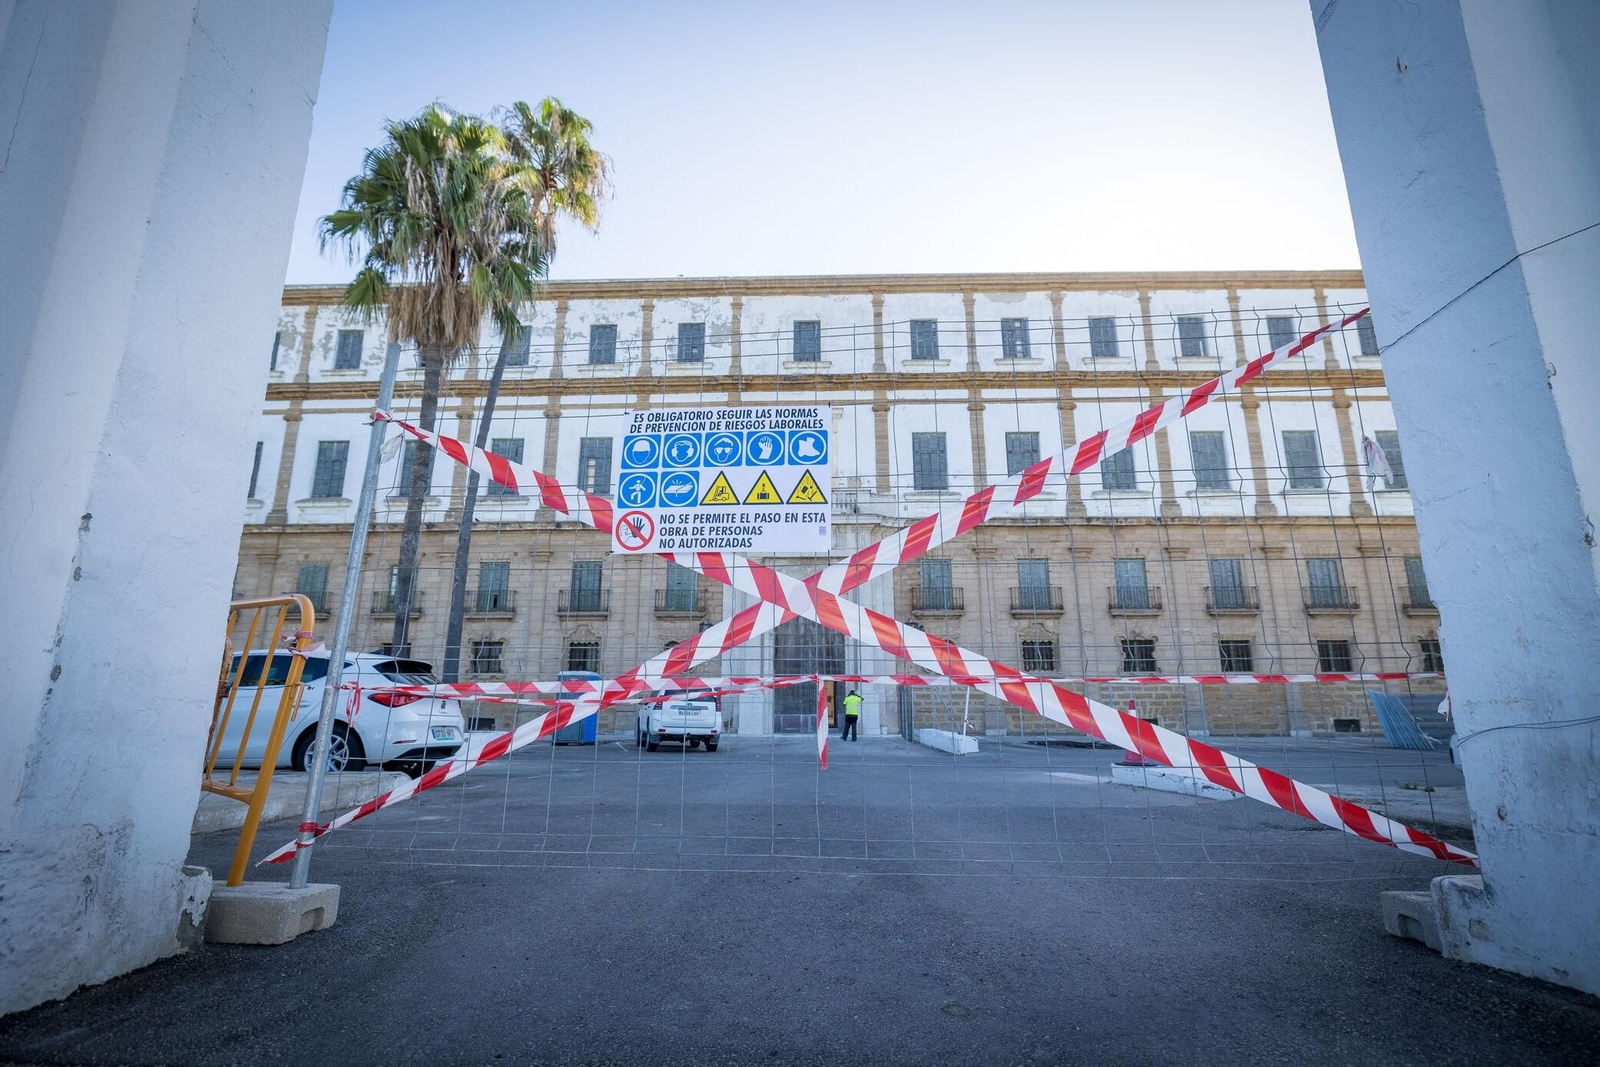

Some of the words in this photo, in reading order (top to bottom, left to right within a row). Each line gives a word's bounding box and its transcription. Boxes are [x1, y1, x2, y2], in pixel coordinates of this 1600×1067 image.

[634, 413, 644, 422] ES
[647, 411, 713, 421] OBLIGATORIO
[716, 410, 752, 420] SEGUIR
[755, 409, 772, 419] LAS
[775, 409, 818, 418] NORMAS
[630, 423, 642, 433] DE
[645, 421, 705, 432] PREVENCION
[709, 421, 721, 431] DE
[725, 420, 766, 430] RIESGOS
[769, 419, 823, 429] LABORALES
[660, 514, 675, 524] NO
[679, 514, 689, 523] SE
[693, 513, 736, 524] PERMITE
[741, 513, 750, 523] EL
[755, 513, 781, 523] PASO
[785, 513, 798, 522] EN
[802, 512, 826, 523] ESTA
[660, 527, 689, 536] OBRA
[692, 526, 705, 536] DE
[709, 526, 763, 536] PERSONAS
[659, 539, 675, 548] NO
[678, 538, 752, 548] AUTORIZADAS
